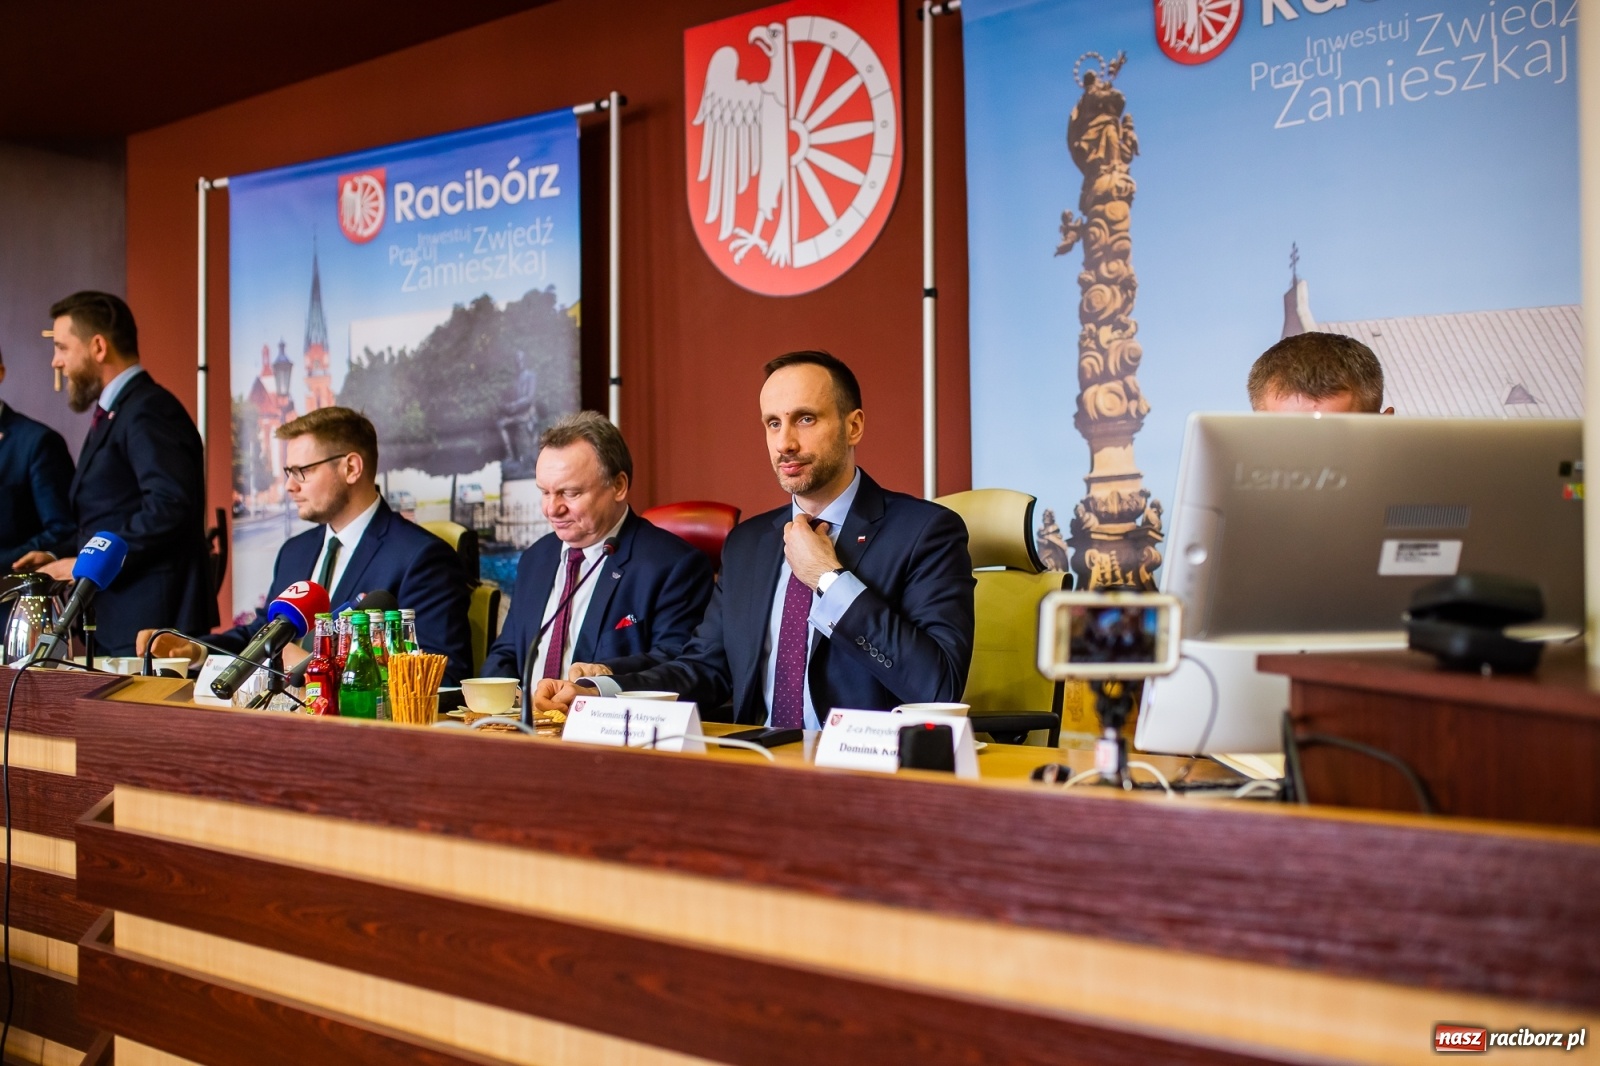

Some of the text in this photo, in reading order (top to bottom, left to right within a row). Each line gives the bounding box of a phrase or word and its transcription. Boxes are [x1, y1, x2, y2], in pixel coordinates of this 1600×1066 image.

[1306, 12, 1409, 58] Inwestuj
[1250, 51, 1342, 91] Pracuj
[1272, 35, 1567, 128] Zamieszkaj
[394, 156, 561, 223] Racibórz
[389, 244, 438, 265] Pracuj
[417, 224, 472, 247] Inwestuj
[473, 216, 554, 255] Zwiedź
[401, 244, 547, 293] Zamieszkaj
[839, 742, 878, 755] Dominik
